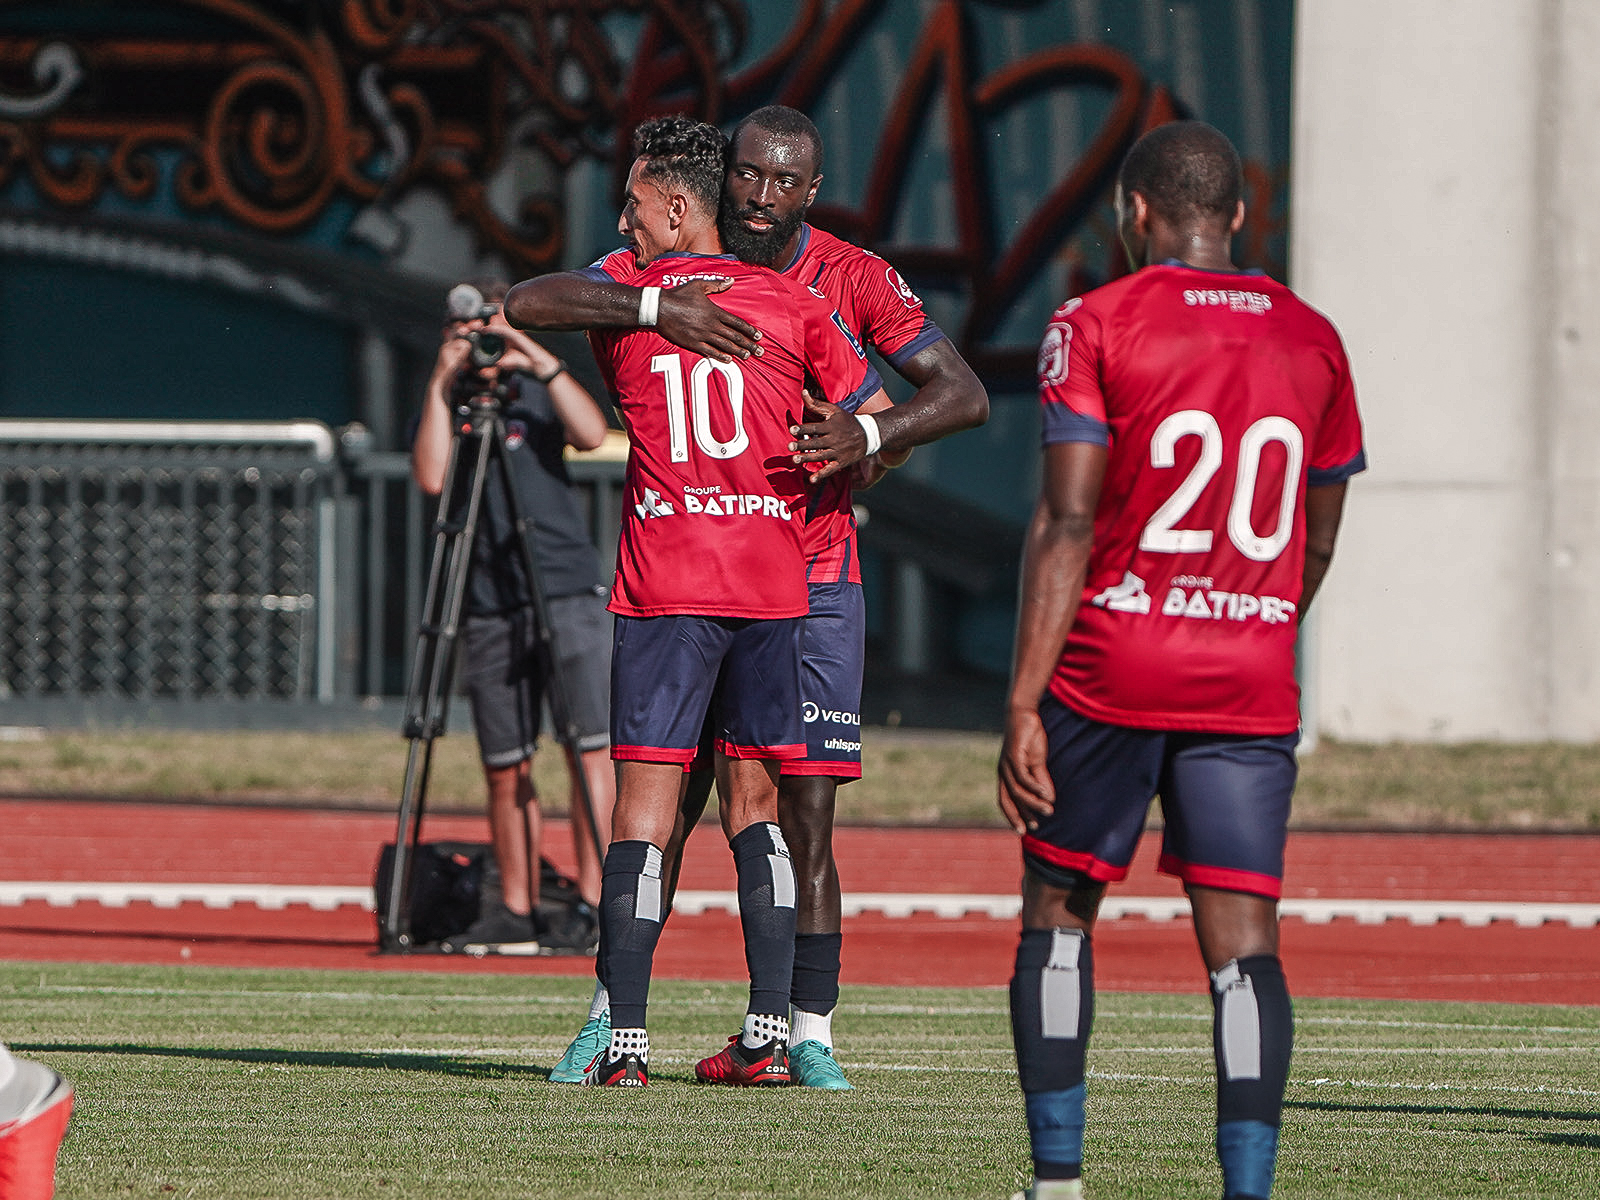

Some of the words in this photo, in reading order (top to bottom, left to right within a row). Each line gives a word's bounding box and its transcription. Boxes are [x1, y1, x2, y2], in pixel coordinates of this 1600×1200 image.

[650, 353, 749, 463] 10
[683, 485, 722, 495] GROUPE
[1138, 409, 1304, 562] 20
[765, 1065, 789, 1074] COPA
[619, 1078, 643, 1087] COPA
